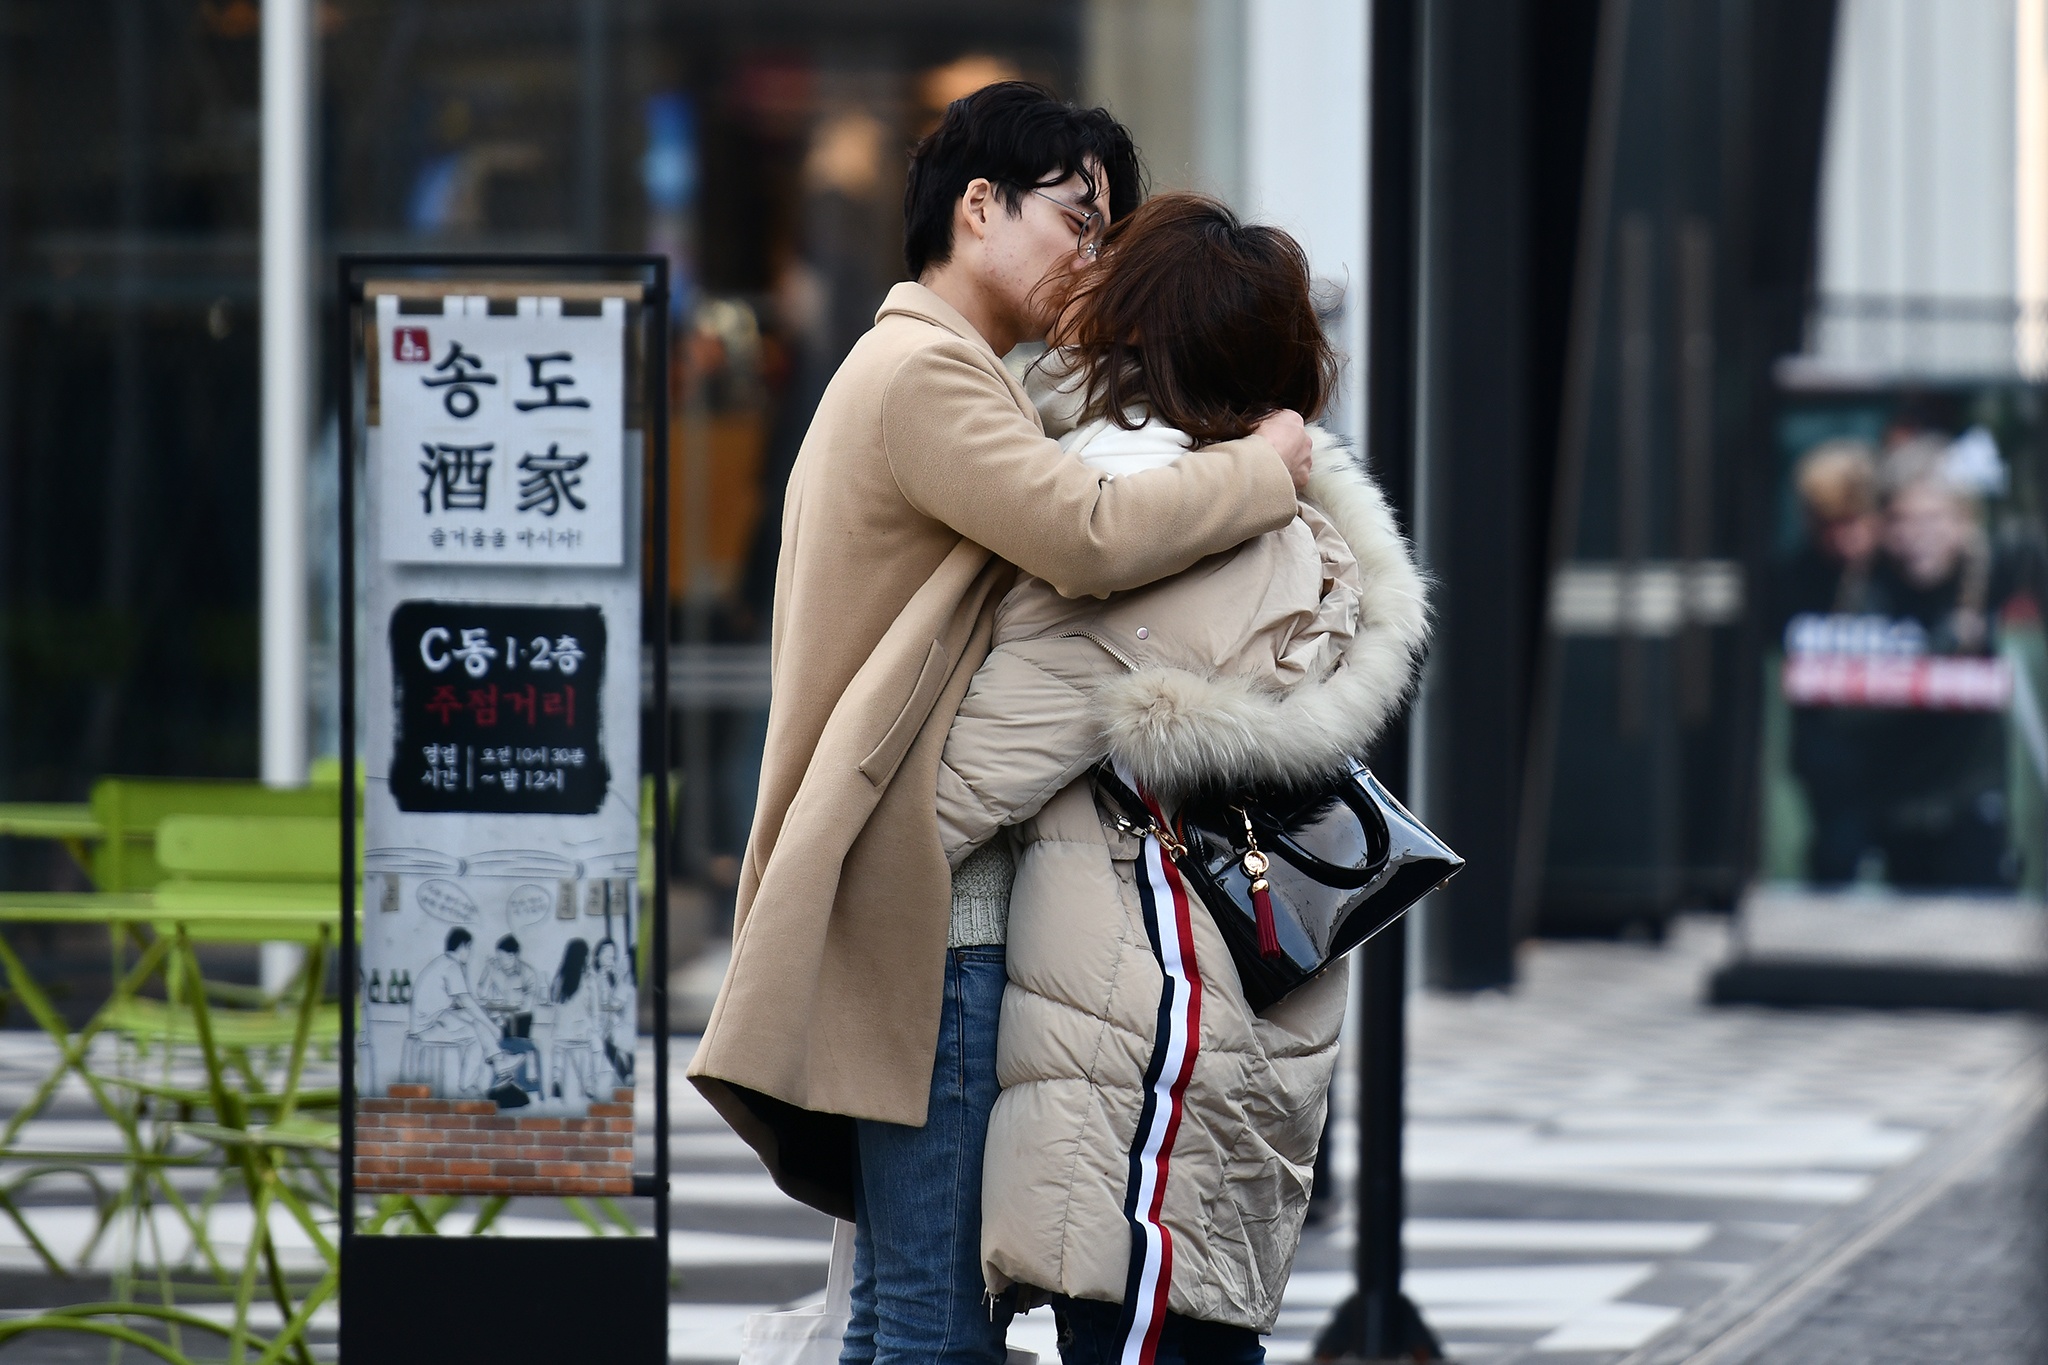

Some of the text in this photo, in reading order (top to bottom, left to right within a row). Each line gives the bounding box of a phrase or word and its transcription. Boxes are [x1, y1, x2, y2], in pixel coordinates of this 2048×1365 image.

[419, 626, 498, 678] C동
[425, 683, 576, 727] 주점거리
[422, 743, 458, 767] 영업
[421, 768, 458, 790] 시간
